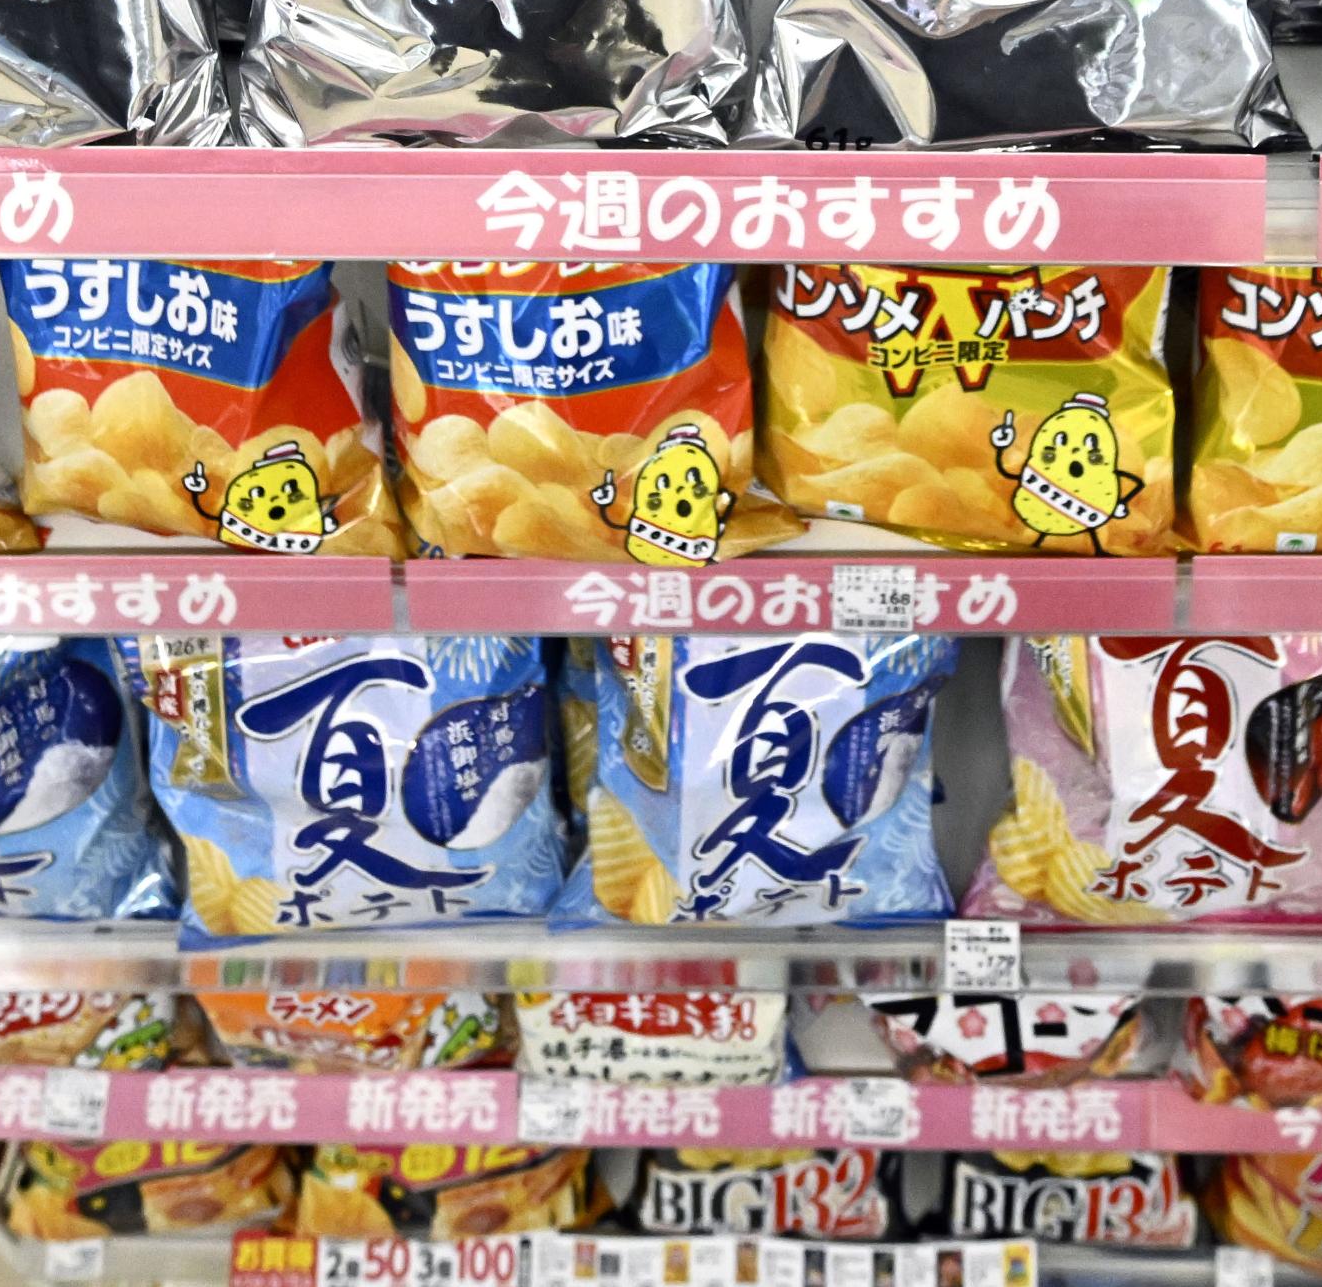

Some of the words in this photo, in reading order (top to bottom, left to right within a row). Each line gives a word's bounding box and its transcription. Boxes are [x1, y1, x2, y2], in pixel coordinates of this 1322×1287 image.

[477, 168, 1062, 253] 今週のおすすめ
[25, 261, 239, 344] うすしお味
[403, 294, 643, 362] うすしお味
[52, 324, 213, 370] コンビニ限定サイズ
[436, 356, 616, 388] コンビニ限定サイズ
[869, 339, 1008, 371] コンビニ限定
[1023, 472, 1102, 526] POTATO
[564, 575, 1018, 628] 今週のおすめ
[234, 656, 494, 893] 夏
[681, 639, 871, 892] 夏
[1098, 635, 1307, 868] 夏
[277, 888, 474, 927] ポテト
[1090, 848, 1287, 908] ポテト
[270, 996, 375, 1023] ラーメン
[146, 1077, 297, 1130] 新発売
[347, 1078, 499, 1131] 新発売
[972, 1088, 1122, 1141] 新発売
